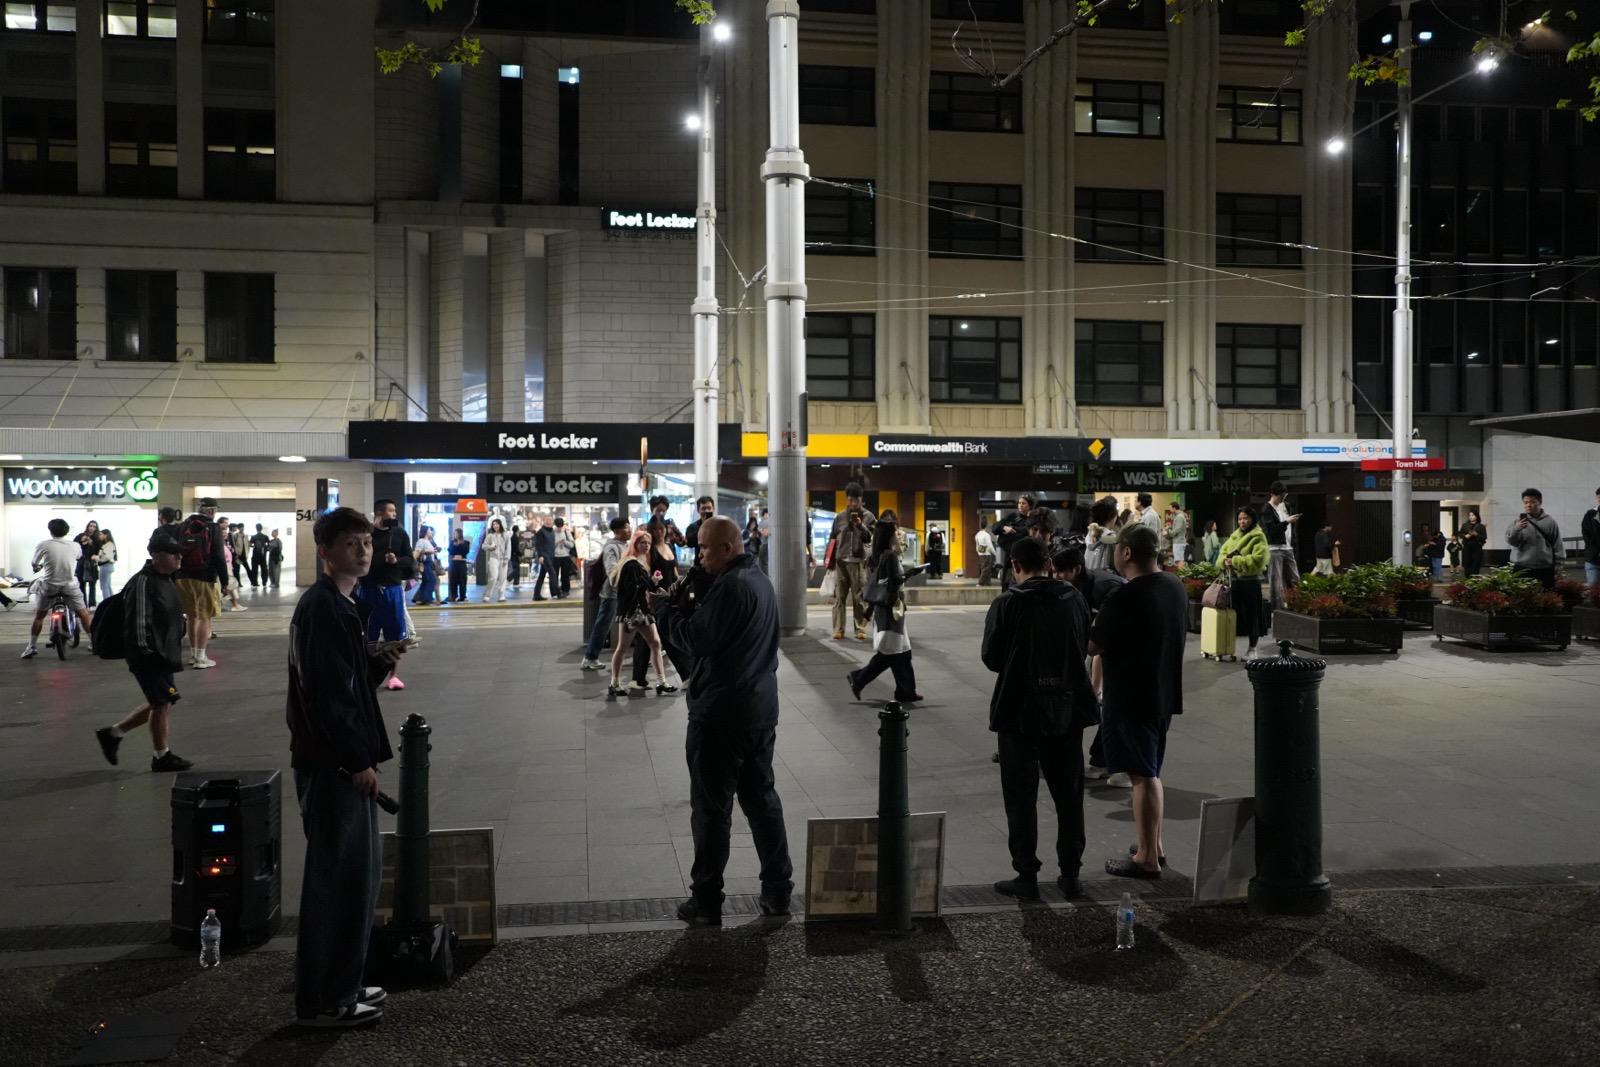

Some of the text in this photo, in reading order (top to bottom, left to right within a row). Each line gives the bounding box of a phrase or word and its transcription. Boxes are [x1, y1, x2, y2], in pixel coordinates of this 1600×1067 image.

[610, 211, 697, 228] Foot Locker
[498, 433, 598, 448] Foot Locker
[874, 441, 988, 454] Commonwealth Bank
[1396, 460, 1428, 468] Town Hall
[8, 475, 124, 495] Woolworths
[493, 476, 613, 493] Foot Locker
[1124, 472, 1182, 487] WAST
[1379, 478, 1464, 487] COGE OF LAW
